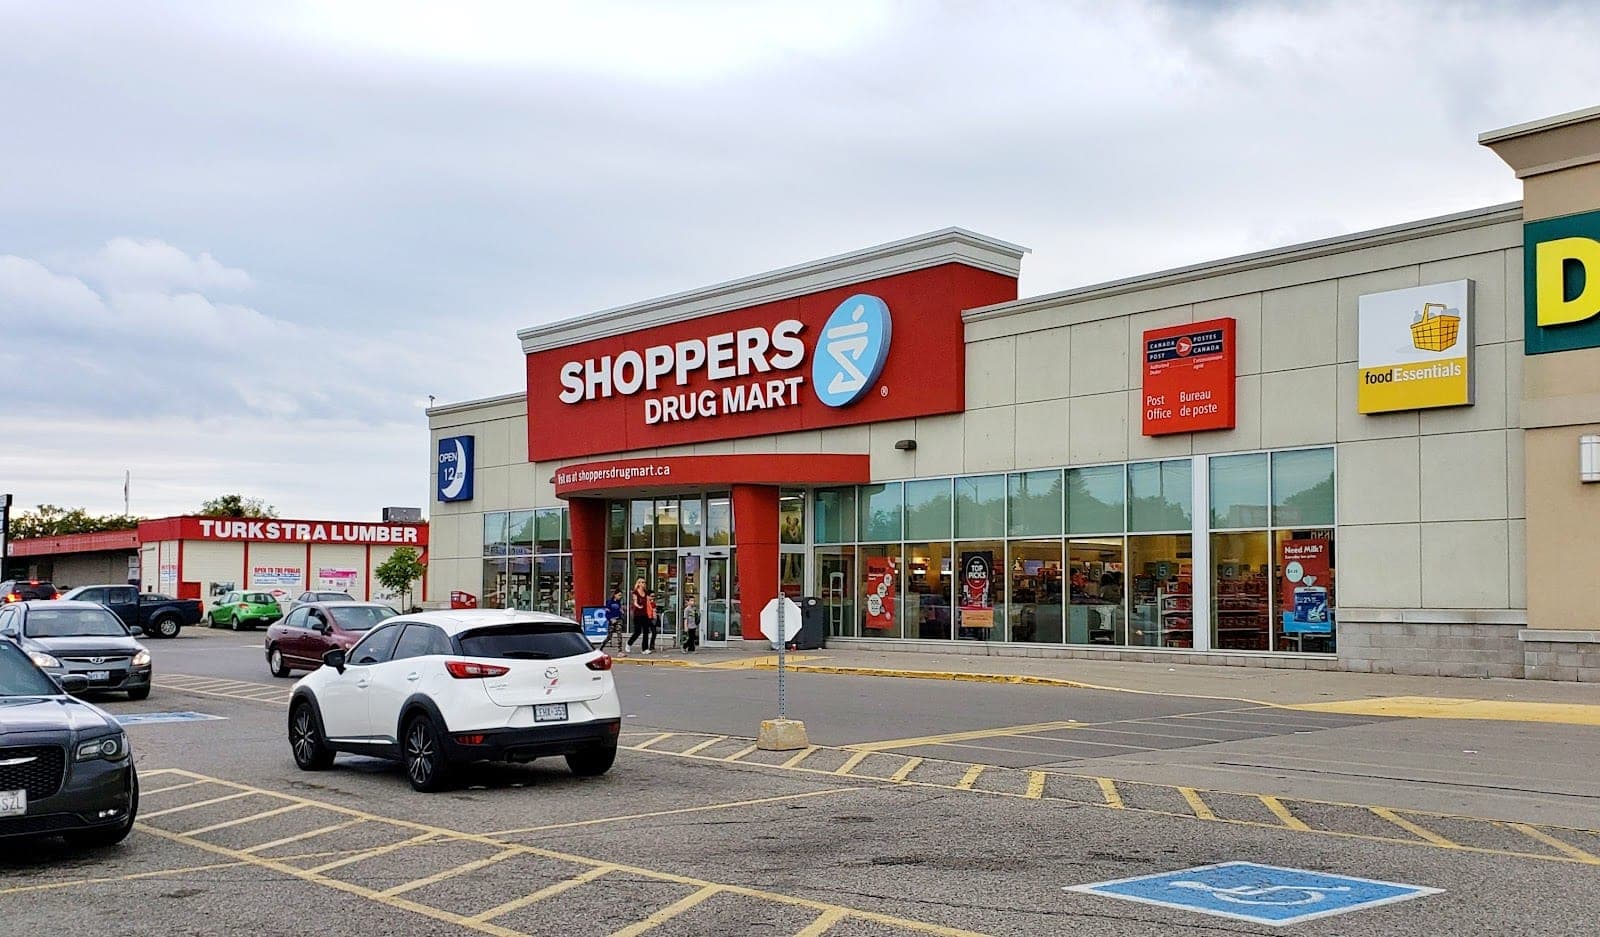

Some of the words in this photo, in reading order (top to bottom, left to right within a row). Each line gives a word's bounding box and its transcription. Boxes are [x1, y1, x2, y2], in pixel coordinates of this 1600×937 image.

[1193, 334, 1217, 342] POSTES
[1150, 341, 1175, 349] CANADA
[1193, 345, 1220, 353] CANADA
[559, 319, 805, 404] SHOPPERS
[645, 389, 717, 424] DRUG
[722, 376, 803, 414] MART
[1147, 395, 1165, 406] Post
[1180, 390, 1211, 402] Bureau
[1147, 408, 1172, 420] Office
[1180, 405, 1191, 417] de
[1193, 404, 1218, 418] poste
[440, 452, 458, 463] OPEN
[444, 467, 455, 481] 12
[578, 465, 671, 482] shoppersdrugmart.ca
[199, 520, 328, 541] TURKSTRA
[331, 524, 418, 543] LUMBER
[1284, 546, 1303, 554] Need
[1304, 544, 1323, 553] Milk?
[968, 571, 986, 579] PICKS
[1159, 566, 1167, 579] 5
[1225, 567, 1233, 577] 4
